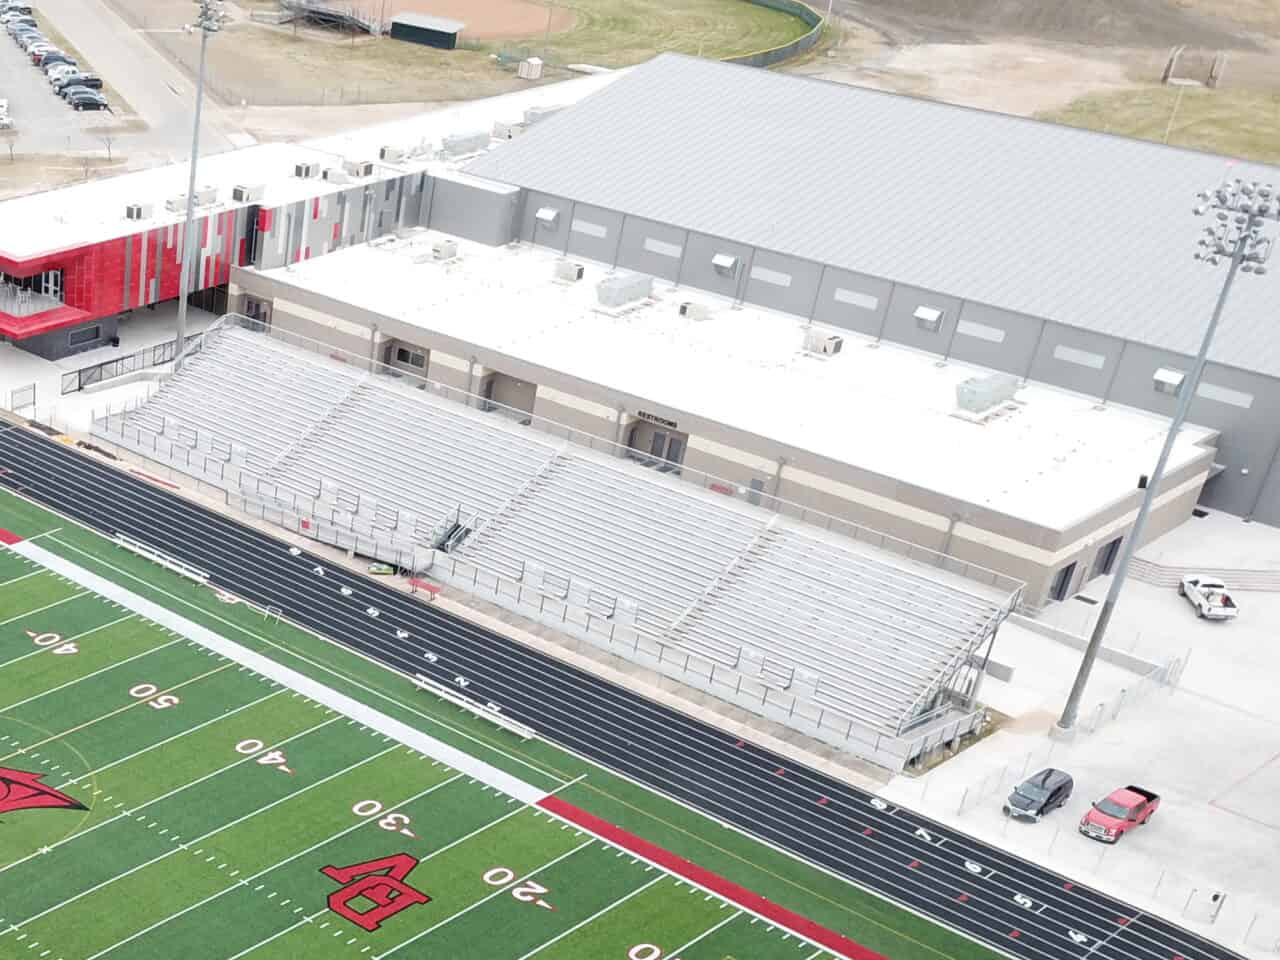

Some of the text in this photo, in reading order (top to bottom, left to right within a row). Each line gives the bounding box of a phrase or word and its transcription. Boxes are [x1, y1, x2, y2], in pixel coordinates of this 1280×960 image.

[34, 631, 80, 656] 40
[128, 683, 180, 710] 50
[234, 738, 288, 766] 40
[351, 799, 411, 832] 30
[481, 867, 550, 902] 20
[1013, 894, 1033, 908] 5
[1067, 930, 1088, 943] 4
